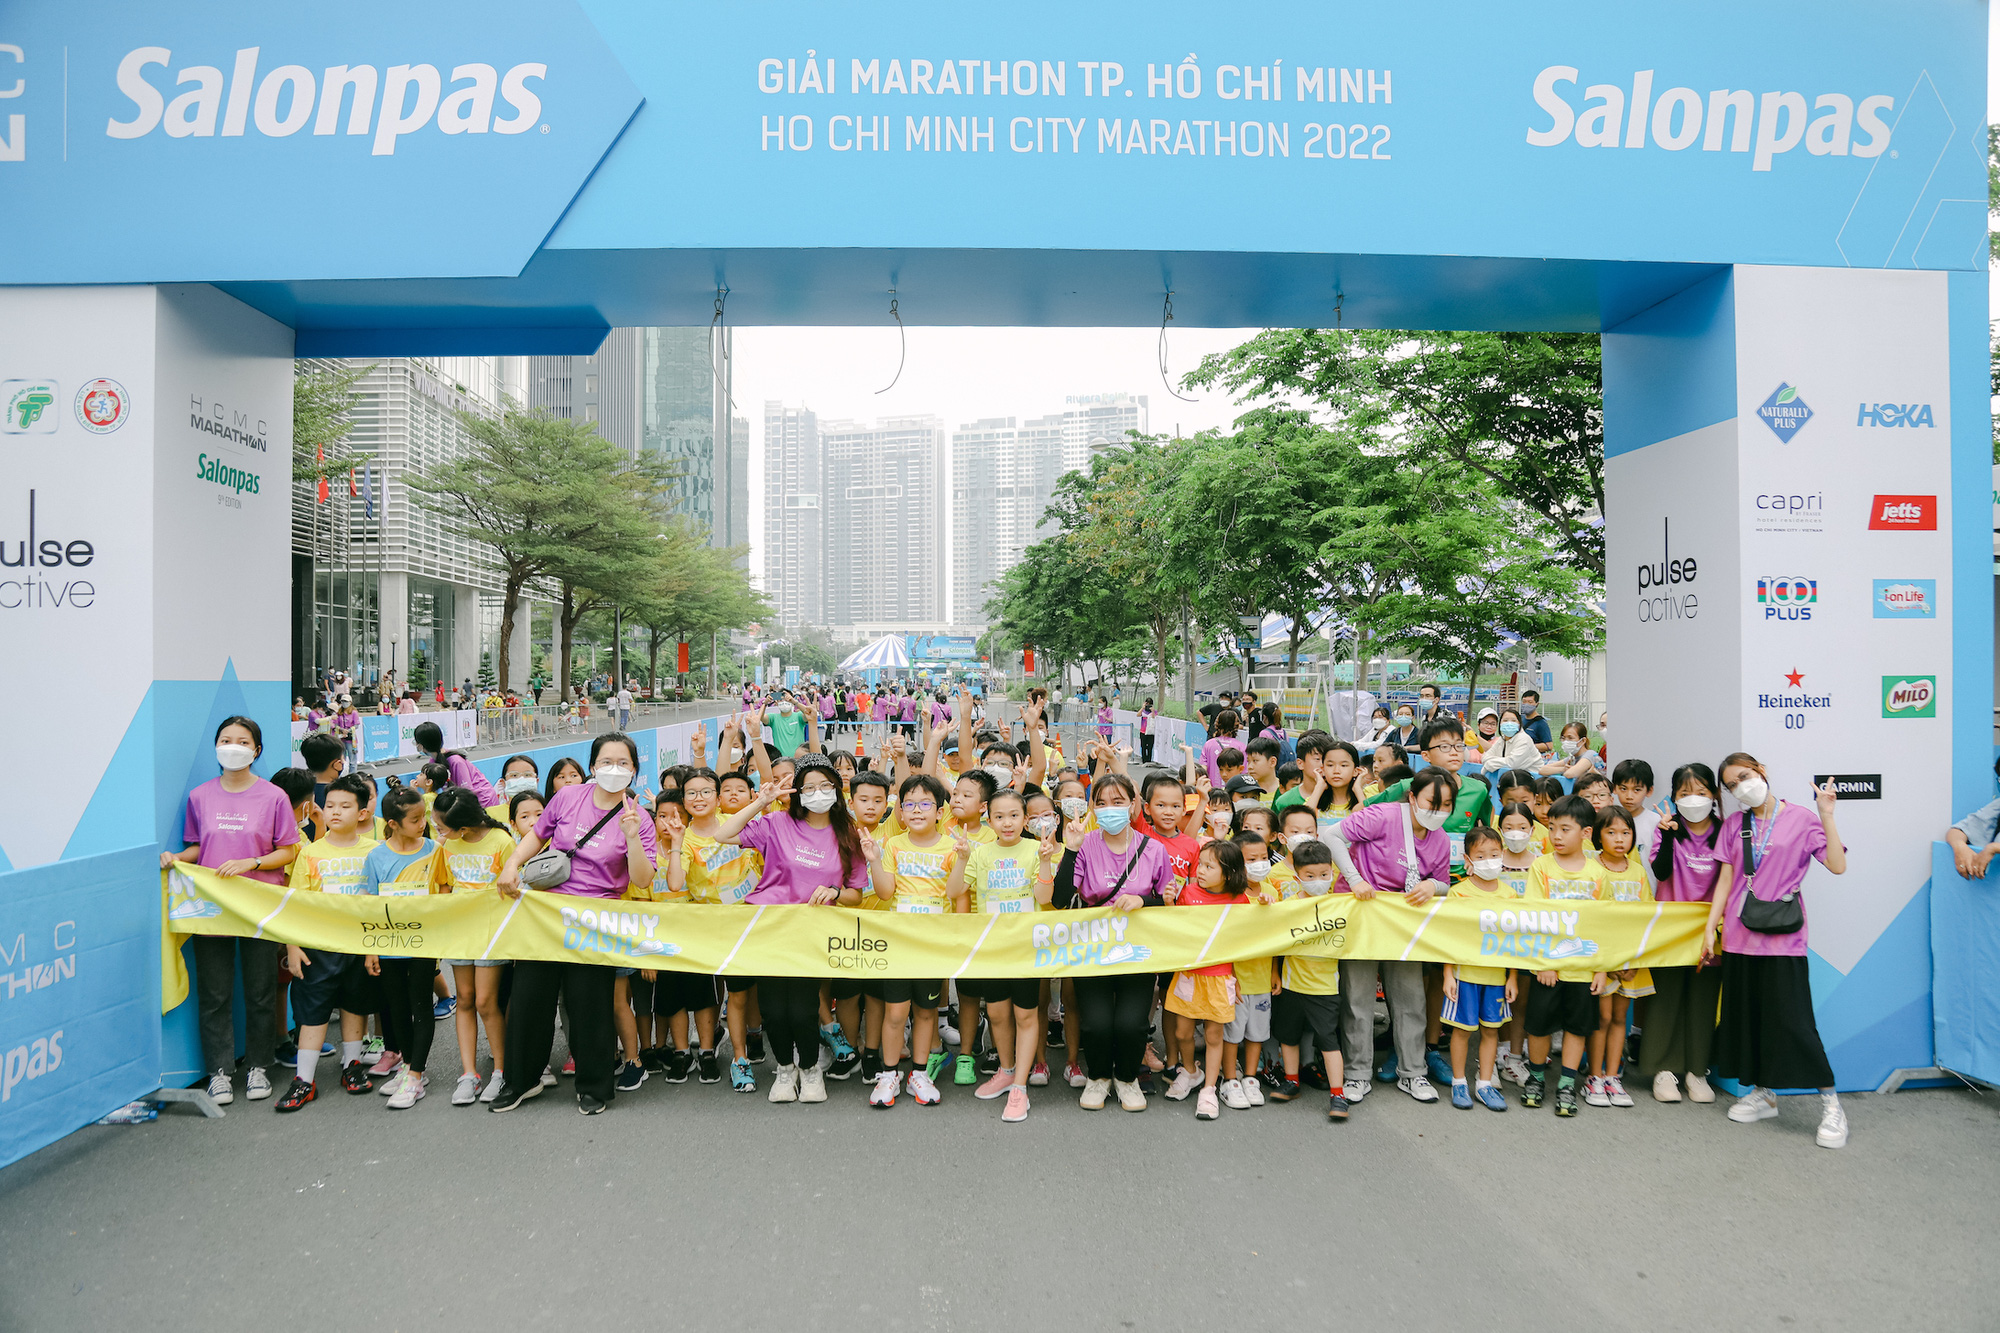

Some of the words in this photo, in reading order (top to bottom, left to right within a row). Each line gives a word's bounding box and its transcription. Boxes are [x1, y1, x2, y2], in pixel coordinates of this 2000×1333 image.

[757, 49, 835, 94] GIẢI
[851, 58, 1066, 97] MARATHON
[1077, 61, 1133, 98] TP.
[1148, 53, 1201, 99] HỒ
[1216, 58, 1282, 102] CHÍ
[1296, 66, 1392, 104] MINH
[105, 46, 548, 155] Salonpas
[1525, 65, 1895, 171] Salonpas
[761, 115, 812, 150] HO
[828, 115, 890, 151] CHI
[905, 116, 995, 152] MINH
[1009, 117, 1086, 153] CITY
[1098, 118, 1290, 157] MARATHON
[1303, 123, 1391, 160] 2022
[1761, 406, 1809, 419] NATURALLY
[1774, 417, 1797, 429] PLUS
[1857, 403, 1935, 428] HOKA
[190, 413, 267, 453] MARATHON
[197, 453, 260, 495] Salonpas
[1756, 491, 1822, 515] capri
[1880, 502, 1922, 522] jetts
[0, 489, 94, 568] ulse
[1638, 517, 1698, 595] pulse
[0, 571, 95, 608] ctive
[1761, 576, 1813, 607] 100
[1905, 591, 1925, 602] Life
[1638, 588, 1699, 623] active
[1765, 608, 1812, 620] PLUS
[1758, 694, 1831, 708] Heineken
[1892, 688, 1929, 705] MILO
[1785, 714, 1805, 730] 0.0
[318, 857, 367, 874] RONN
[897, 851, 945, 868] RONNY
[987, 879, 1015, 889] DASH
[988, 868, 1025, 880] RONNY
[733, 879, 752, 899] 003
[361, 904, 422, 933] pulse
[560, 907, 661, 938] RONNY
[1479, 909, 1580, 936] RONNY
[362, 930, 424, 949] active
[563, 927, 635, 957] DASH
[827, 917, 889, 953] pulse
[1032, 916, 1129, 950] RONNY
[1034, 944, 1106, 968] DASH
[1480, 933, 1552, 959] DASH
[827, 951, 889, 971] active
